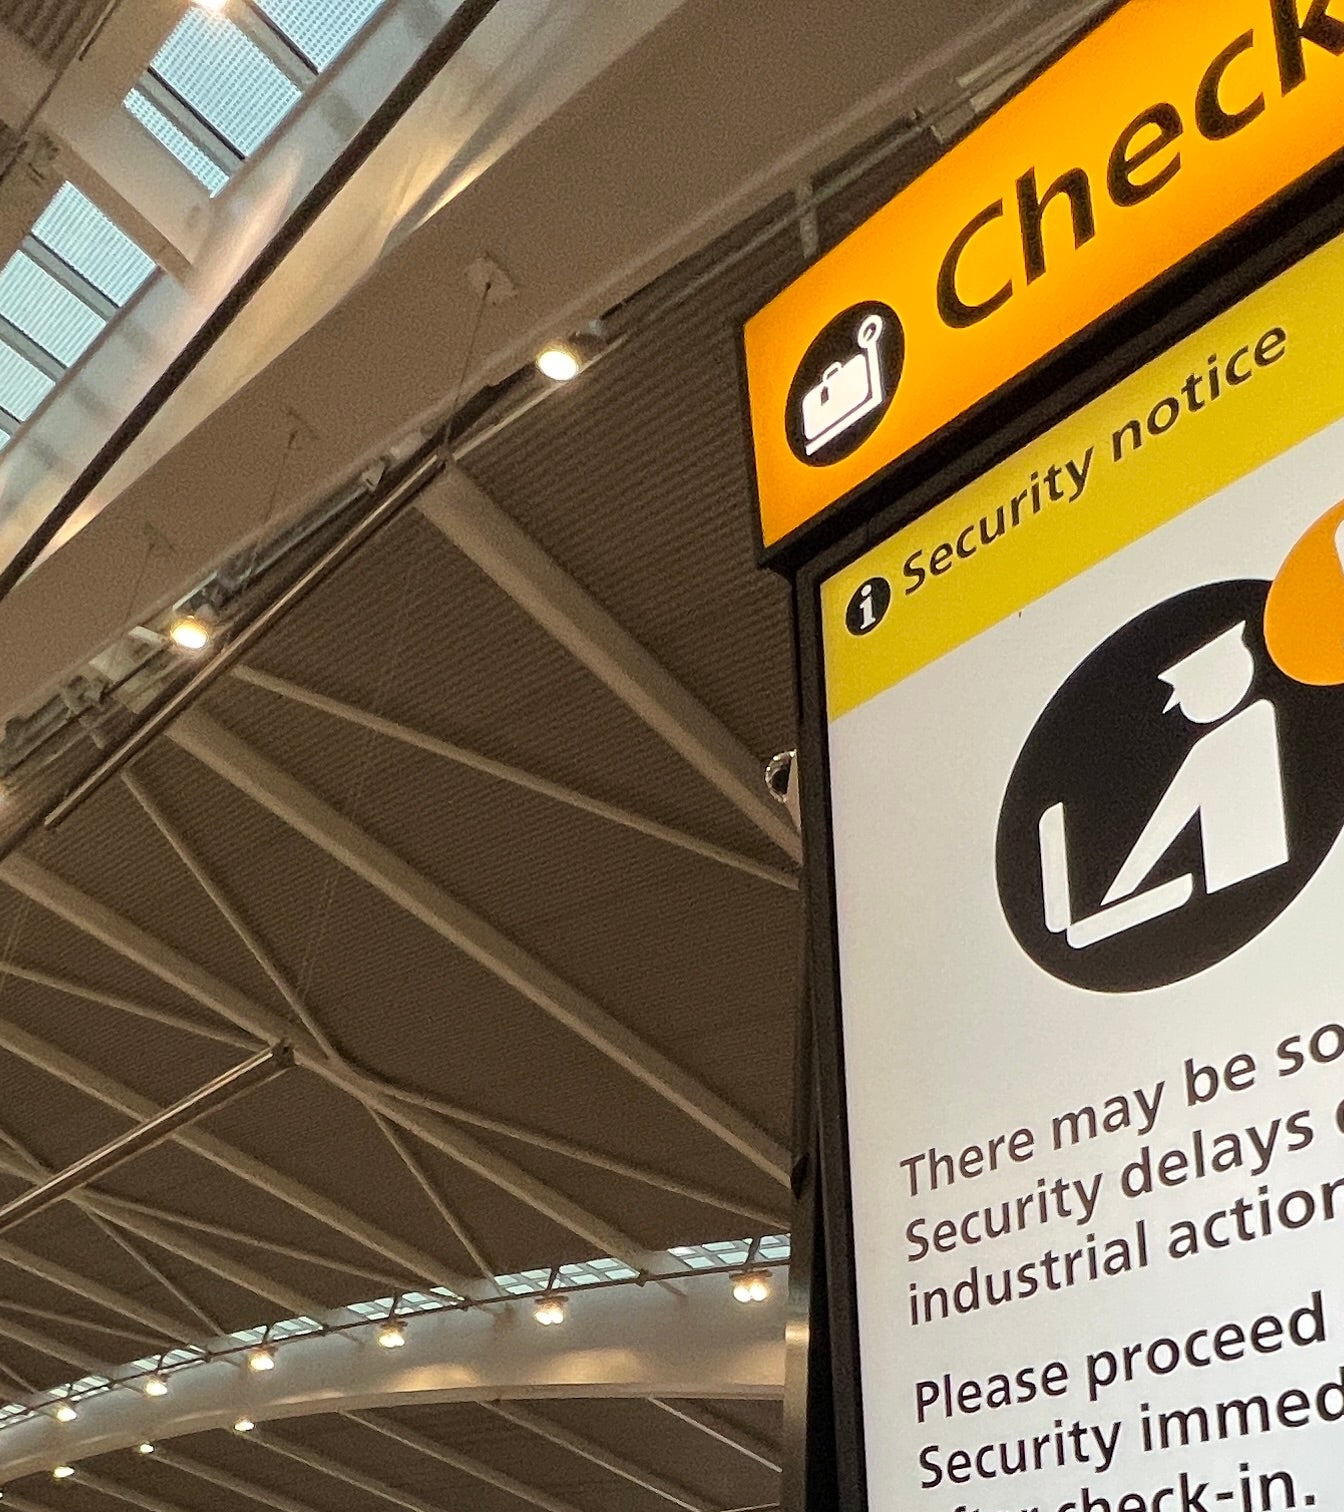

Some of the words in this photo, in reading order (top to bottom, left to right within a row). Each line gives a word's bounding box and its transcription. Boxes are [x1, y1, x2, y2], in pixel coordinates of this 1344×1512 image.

[904, 446, 1094, 595] Security
[1111, 326, 1287, 461] notice
[900, 1129, 1034, 1196] There
[1053, 1081, 1165, 1149] may
[1185, 1055, 1255, 1106] be
[907, 1173, 1102, 1261] Security
[1122, 1111, 1313, 1197] delays
[910, 1220, 1147, 1325] industrial
[916, 1362, 1068, 1423] Please
[1087, 1291, 1325, 1401] proceed
[920, 1420, 1121, 1488] Security
